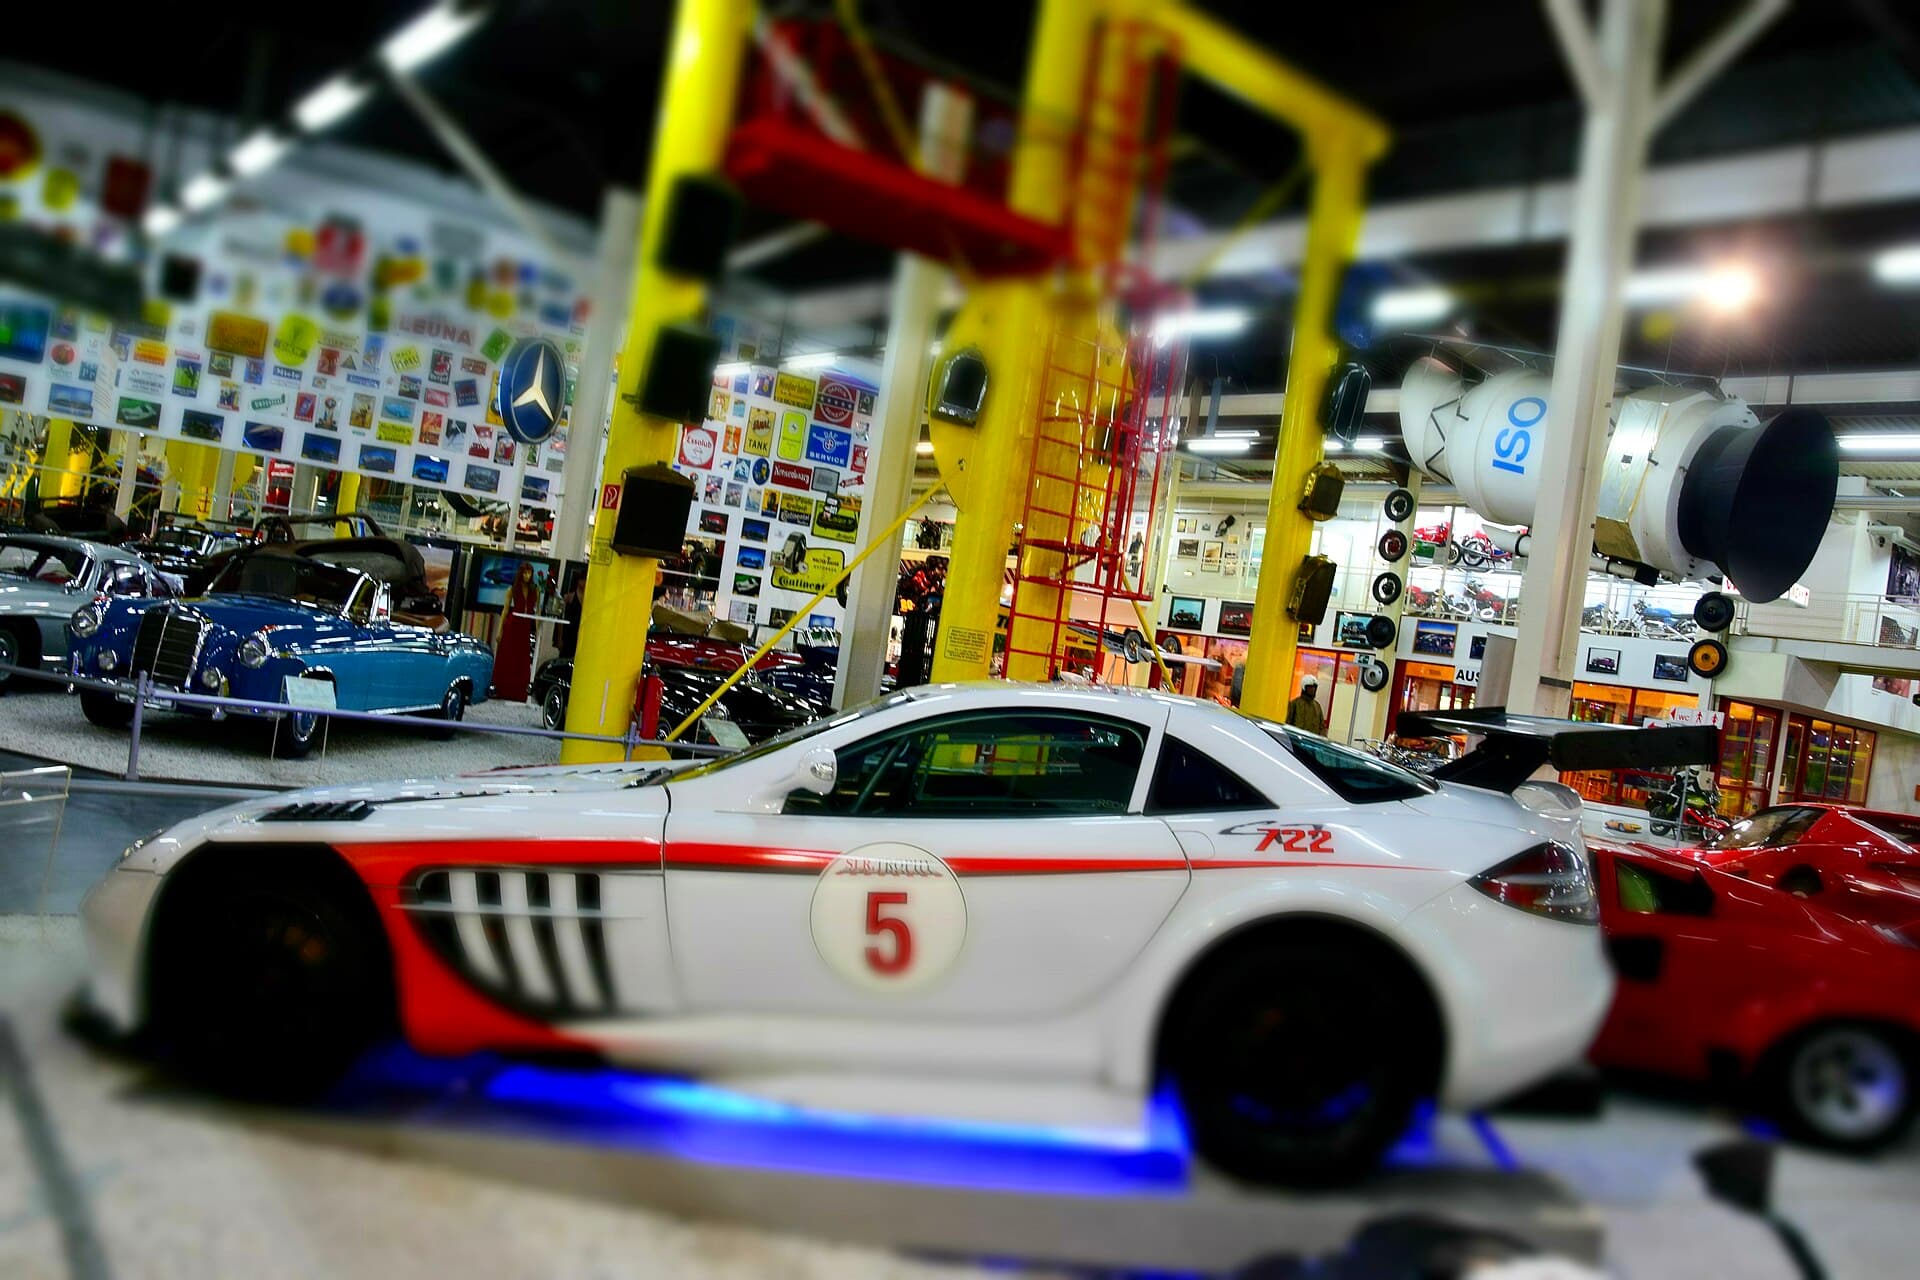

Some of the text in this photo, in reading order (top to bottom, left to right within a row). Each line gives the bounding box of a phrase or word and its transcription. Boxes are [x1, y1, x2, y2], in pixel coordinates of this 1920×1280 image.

[399, 315, 472, 346] LEUNA
[686, 436, 712, 449] Essolub
[748, 439, 768, 451] TANK
[1492, 397, 1548, 475] ISO
[809, 451, 845, 465] SERVICE
[1678, 714, 1690, 722] WC
[1254, 827, 1335, 854] 722
[865, 891, 913, 976] 5
